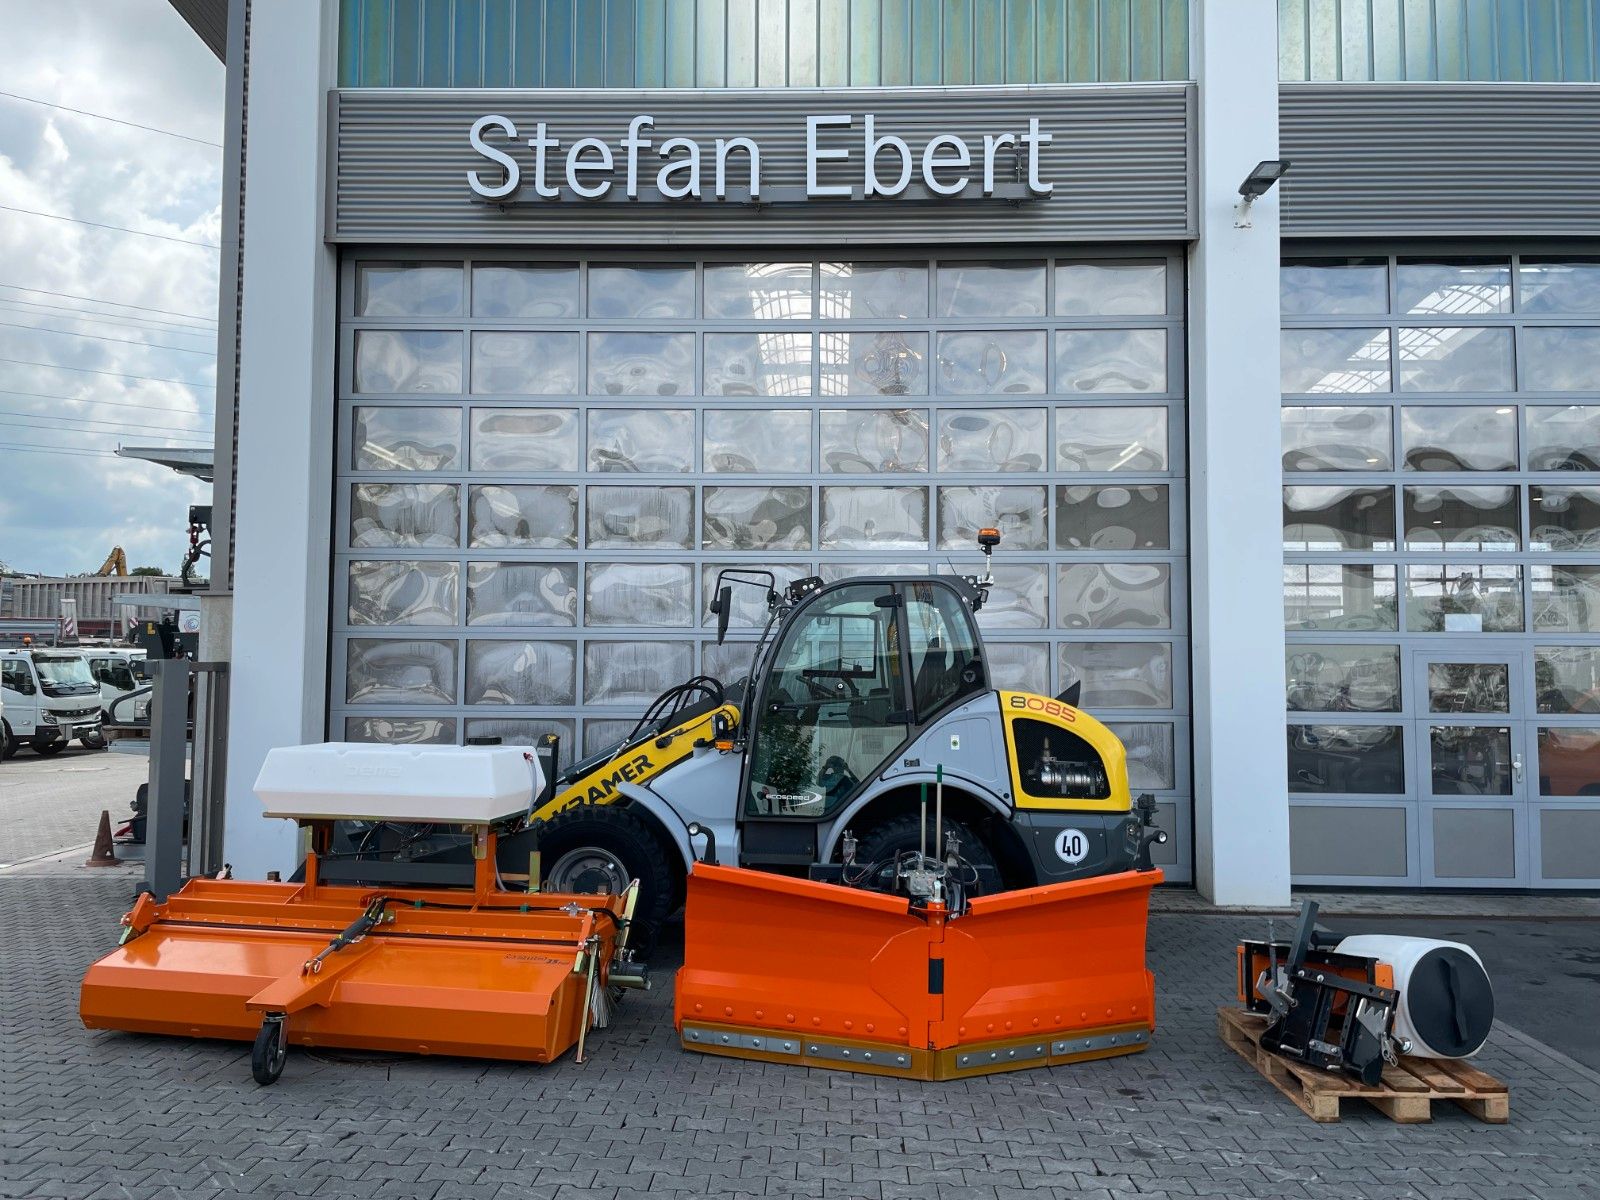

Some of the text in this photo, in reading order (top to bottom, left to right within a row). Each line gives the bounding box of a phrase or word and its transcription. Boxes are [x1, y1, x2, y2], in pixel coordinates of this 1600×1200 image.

[466, 113, 1054, 200] Stefan Ebert
[1010, 695, 1077, 723] 8085
[1061, 835, 1082, 857] 40
